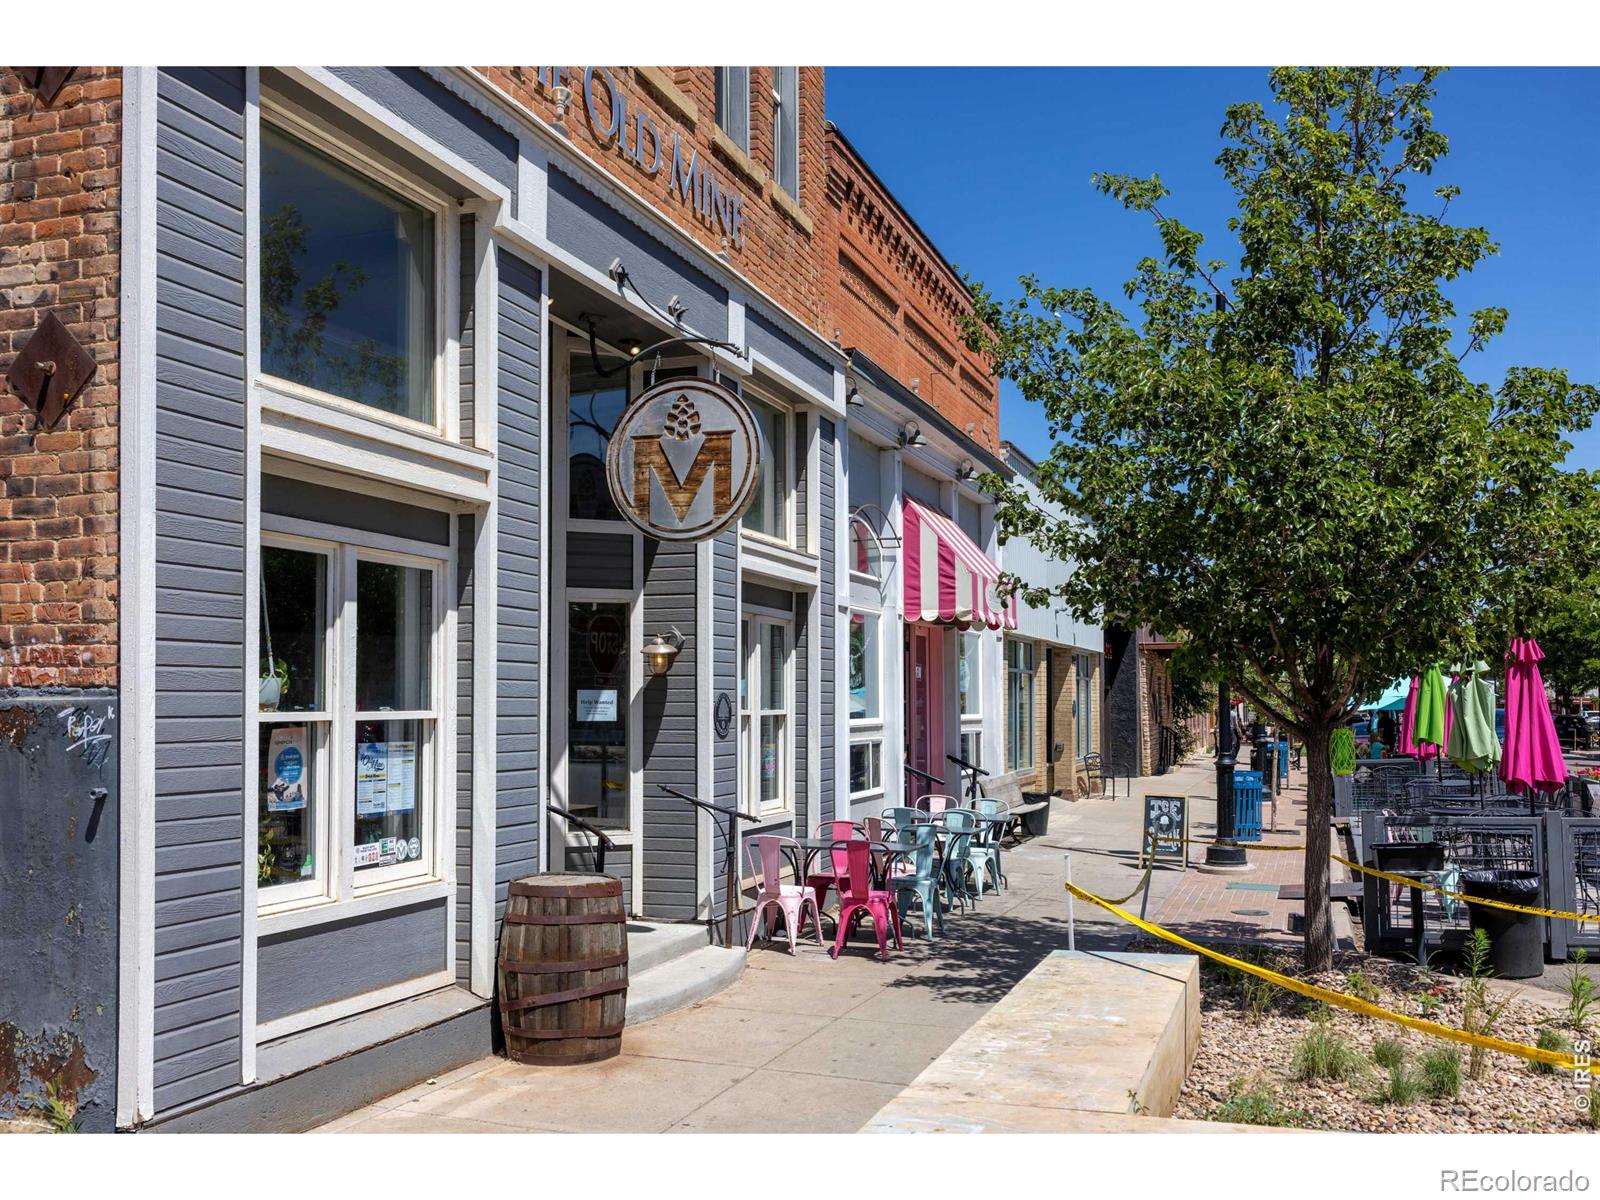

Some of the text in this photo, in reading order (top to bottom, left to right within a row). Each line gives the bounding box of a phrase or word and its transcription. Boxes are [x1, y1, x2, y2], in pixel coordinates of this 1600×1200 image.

[583, 66, 745, 248] OLD MINE
[630, 429, 737, 525] M
[1150, 799, 1182, 821] ICE
